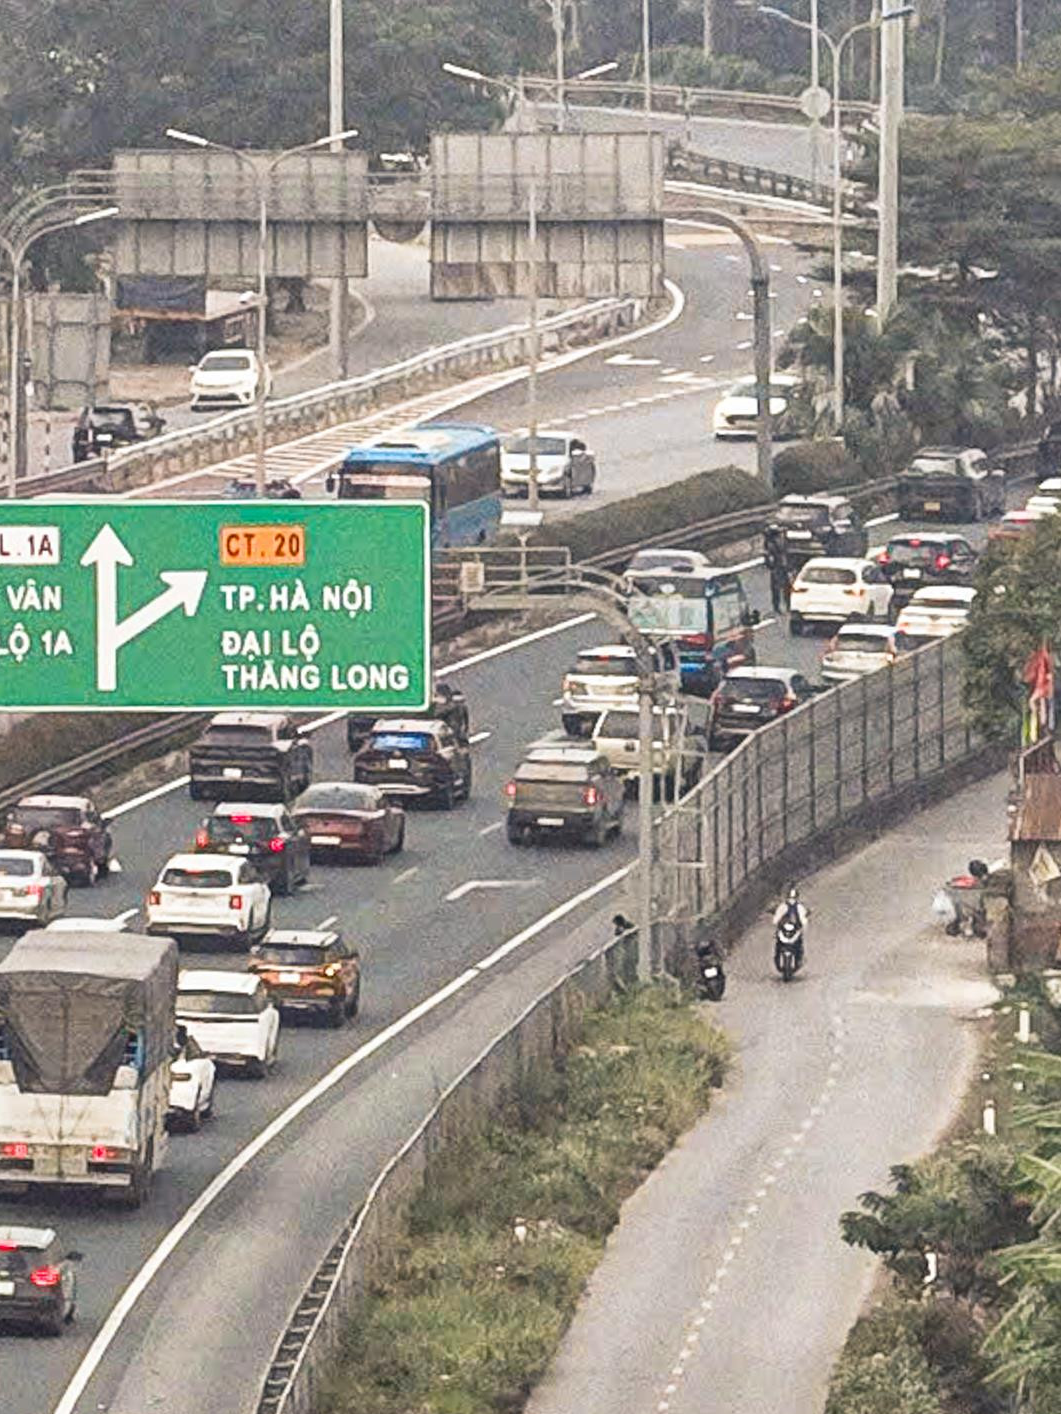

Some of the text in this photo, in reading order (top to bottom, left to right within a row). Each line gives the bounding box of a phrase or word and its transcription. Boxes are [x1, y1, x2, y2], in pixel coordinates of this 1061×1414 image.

[6, 578, 62, 612] VÂN
[322, 578, 373, 619] NỘI
[41, 630, 74, 656] 1A
[220, 623, 321, 663] ĐẠI LỘ
[220, 659, 410, 691] THĂNG LONG
